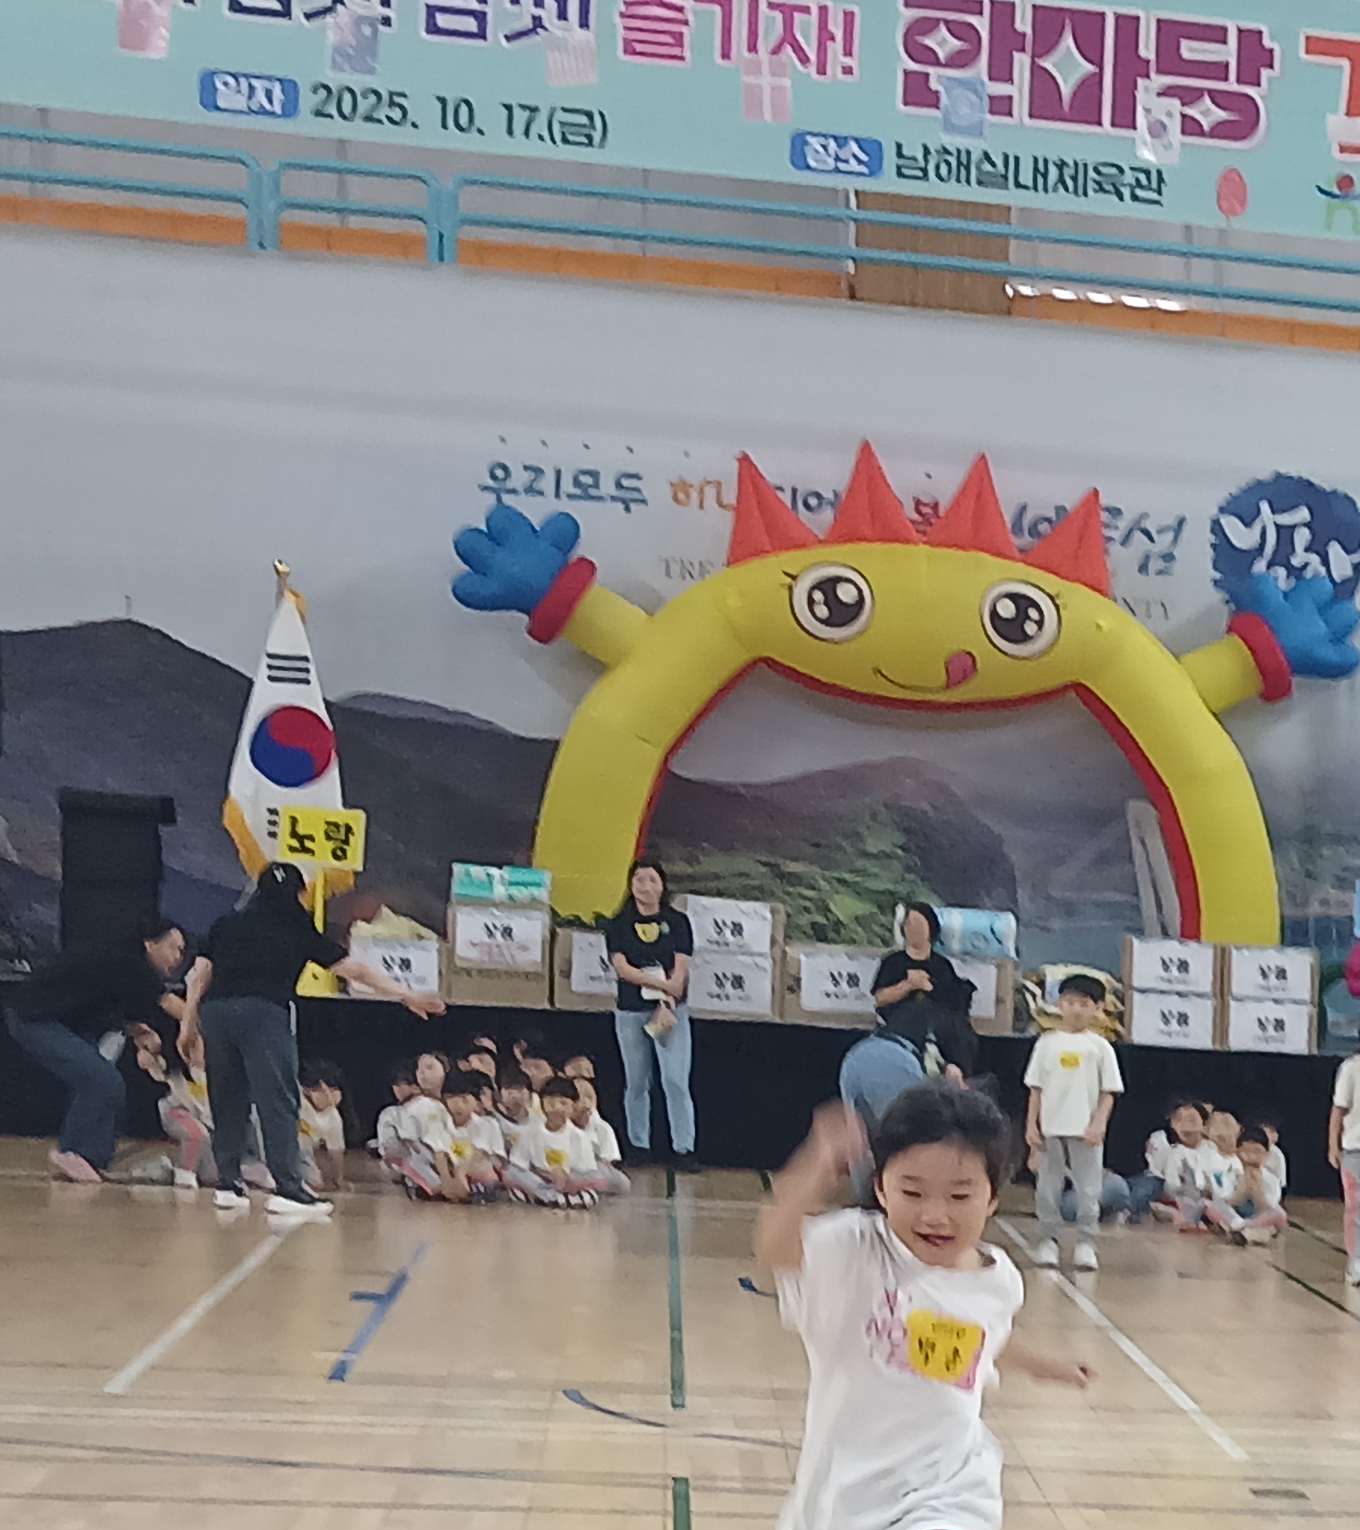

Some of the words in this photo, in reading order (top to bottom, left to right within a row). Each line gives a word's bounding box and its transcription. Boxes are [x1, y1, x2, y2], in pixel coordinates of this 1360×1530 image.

[902, 0, 1275, 140] 한마당
[310, 80, 420, 131] 2025.
[432, 93, 487, 137] 10.
[500, 101, 608, 150] 17.(금)
[803, 134, 871, 176] 장소
[894, 140, 1168, 207] 남해실내체육관
[478, 461, 649, 515] 우리모두
[286, 815, 355, 862] 노랑
